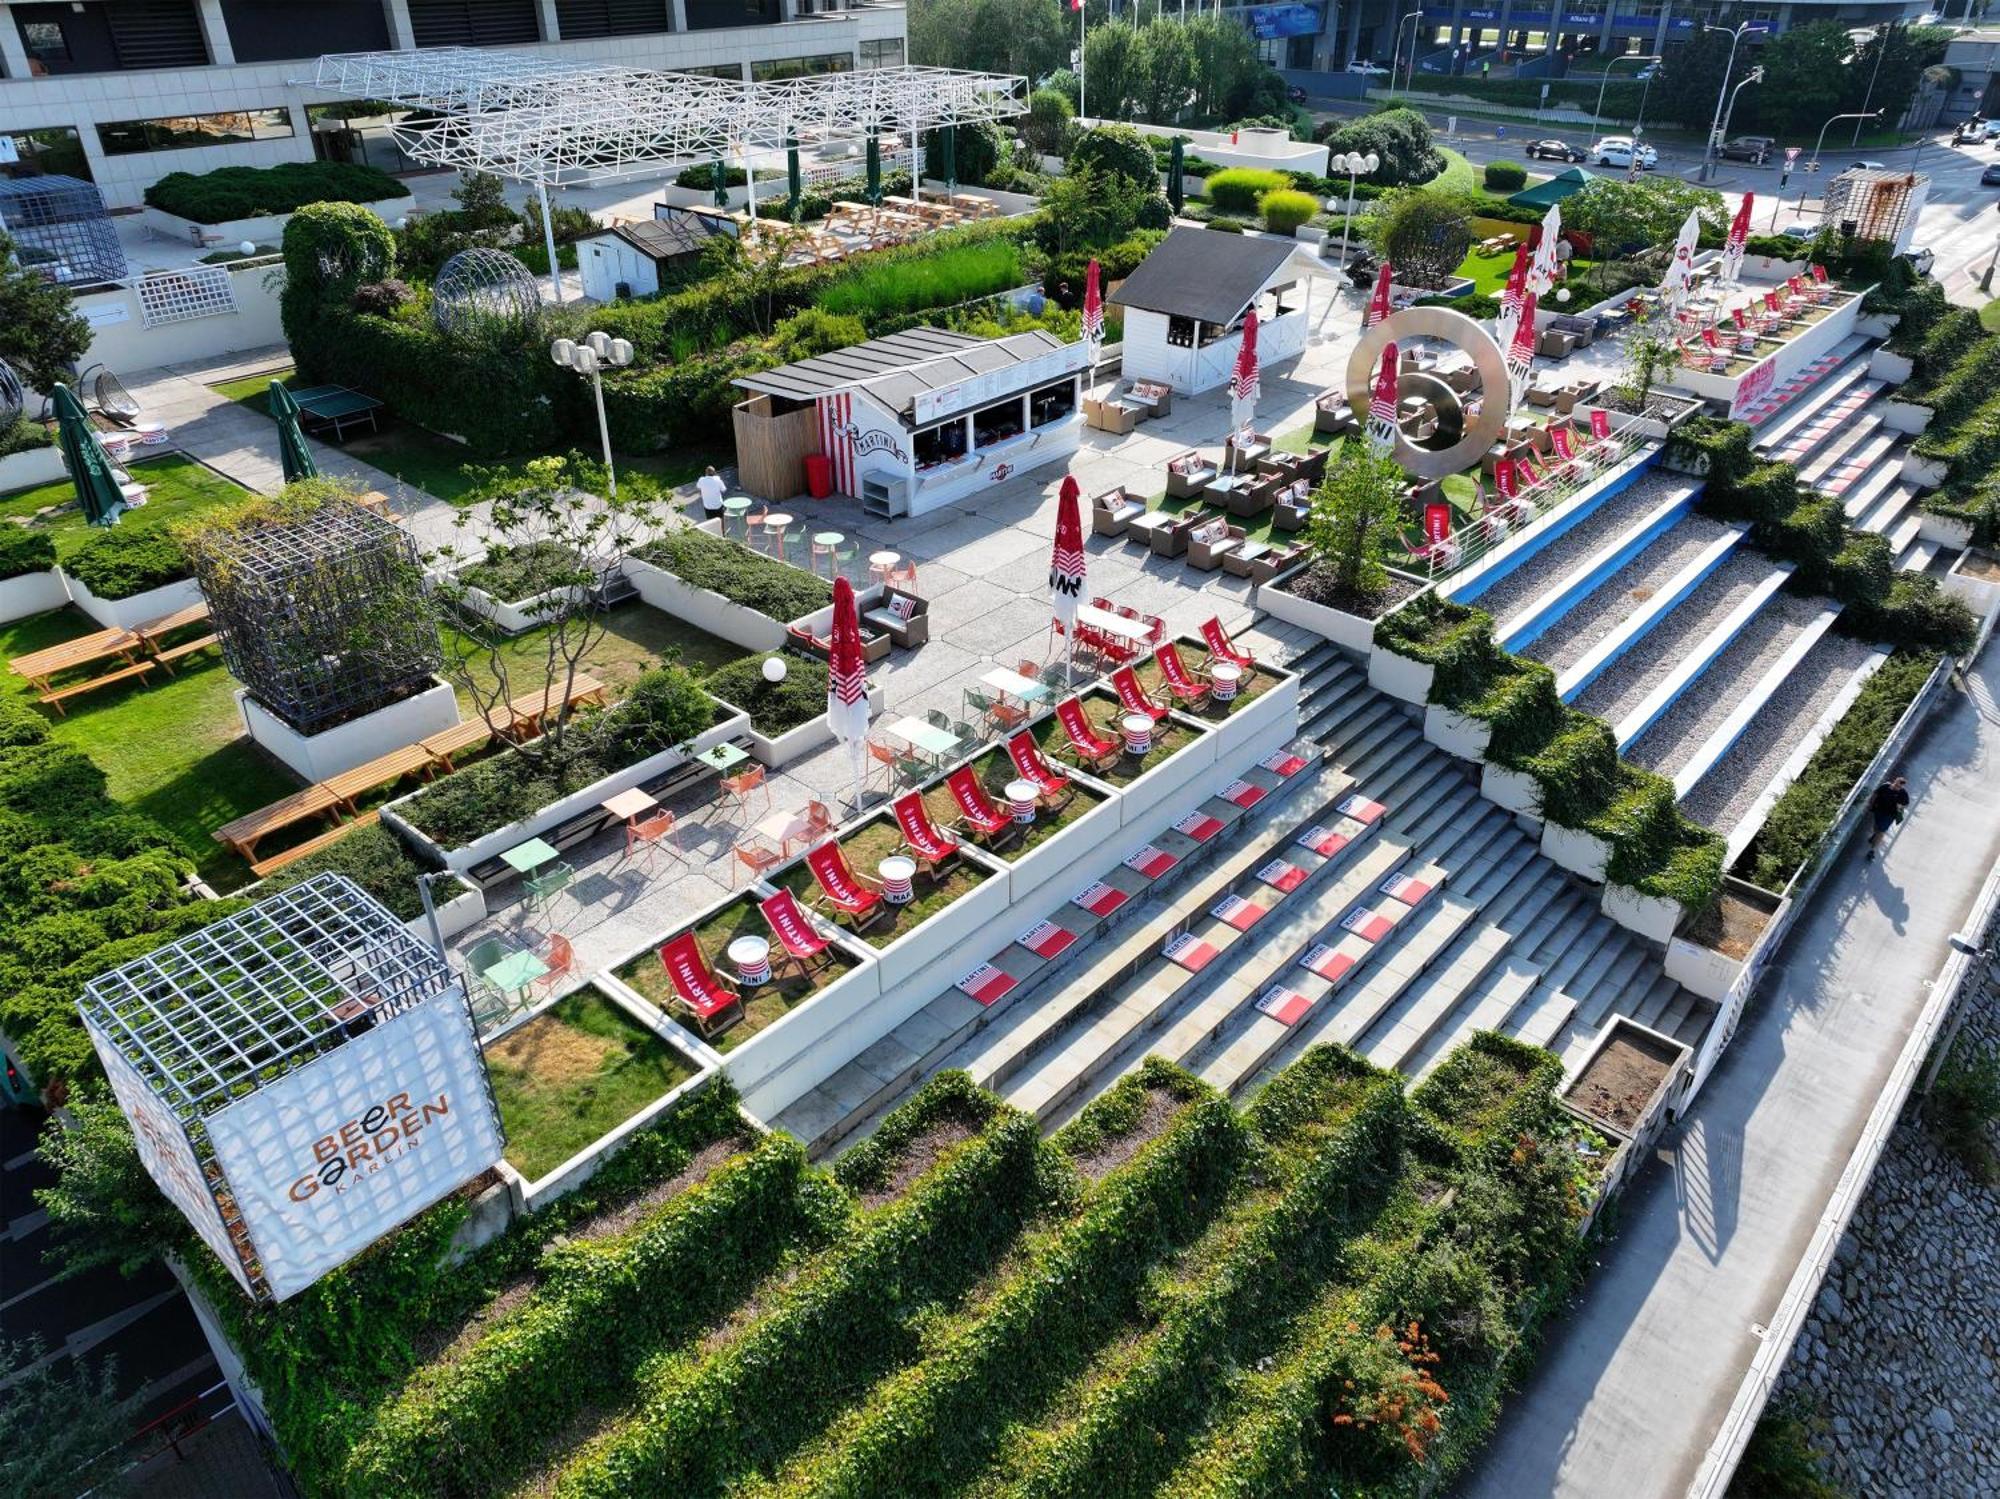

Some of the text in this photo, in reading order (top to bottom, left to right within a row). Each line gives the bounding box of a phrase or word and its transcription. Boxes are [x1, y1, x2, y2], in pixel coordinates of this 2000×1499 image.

[962, 791, 998, 827] MARTINI
[907, 815, 940, 856] MARTINI
[824, 868, 861, 907] MARTINI
[778, 913, 816, 953] MARTINI
[1021, 921, 1049, 943] MARTINI
[678, 962, 715, 1008] MARTINI
[959, 965, 991, 986] MARTINI
